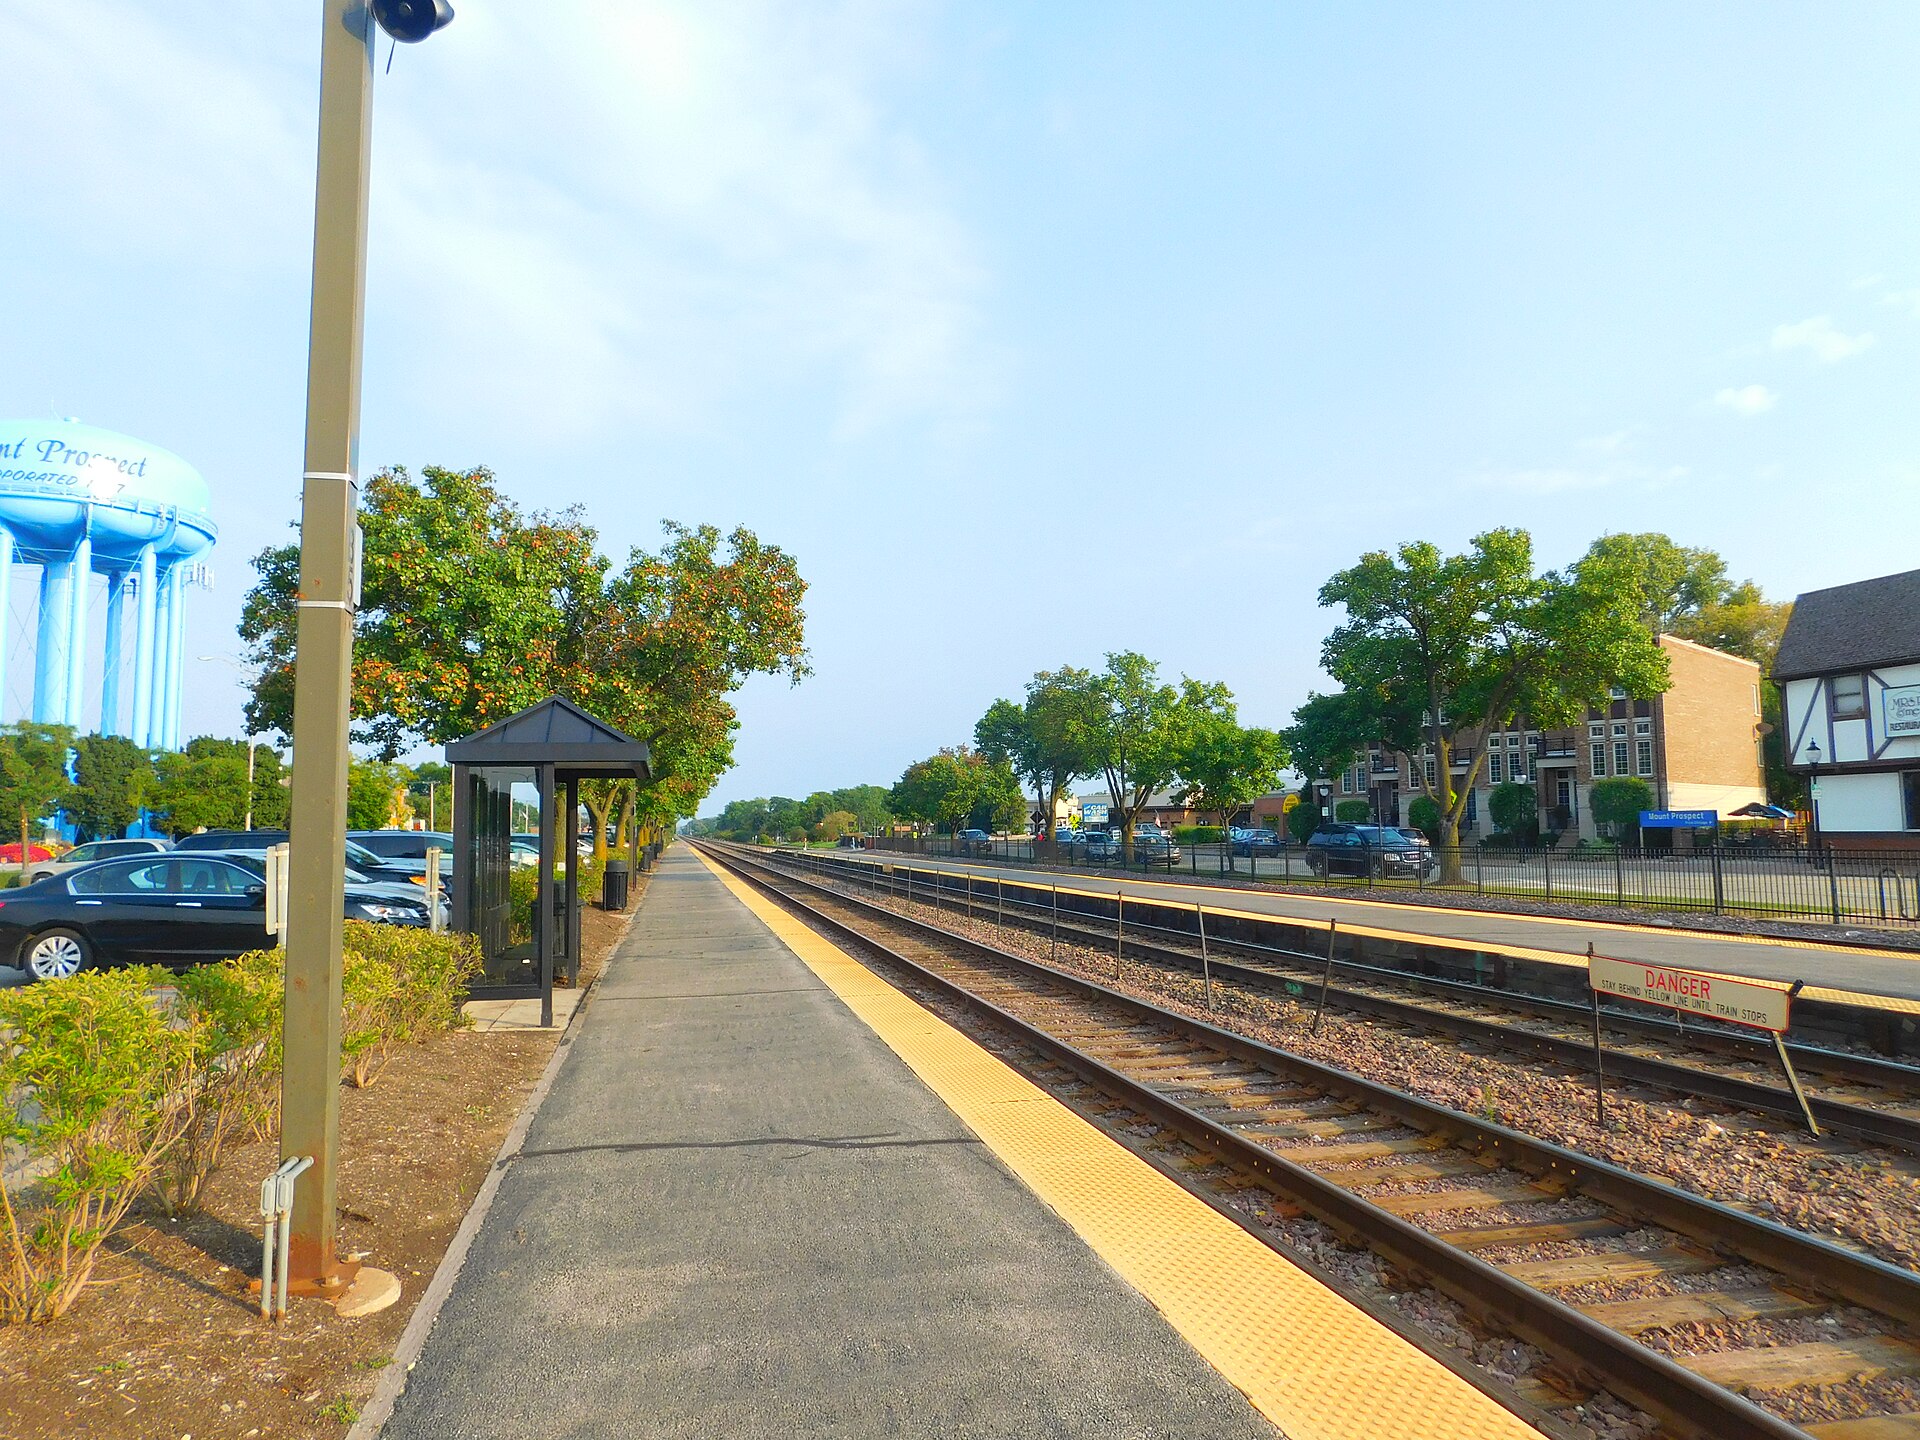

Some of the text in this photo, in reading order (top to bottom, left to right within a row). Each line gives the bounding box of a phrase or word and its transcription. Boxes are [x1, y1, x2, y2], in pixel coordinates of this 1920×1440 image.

[1084, 808, 1107, 816] WASH
[1671, 812, 1704, 821] Prospect
[1645, 969, 1711, 1000] DANGER
[1601, 980, 1767, 1024] STAY BEHIND YELLOW LINE UNTIL TRAIN STOPS
